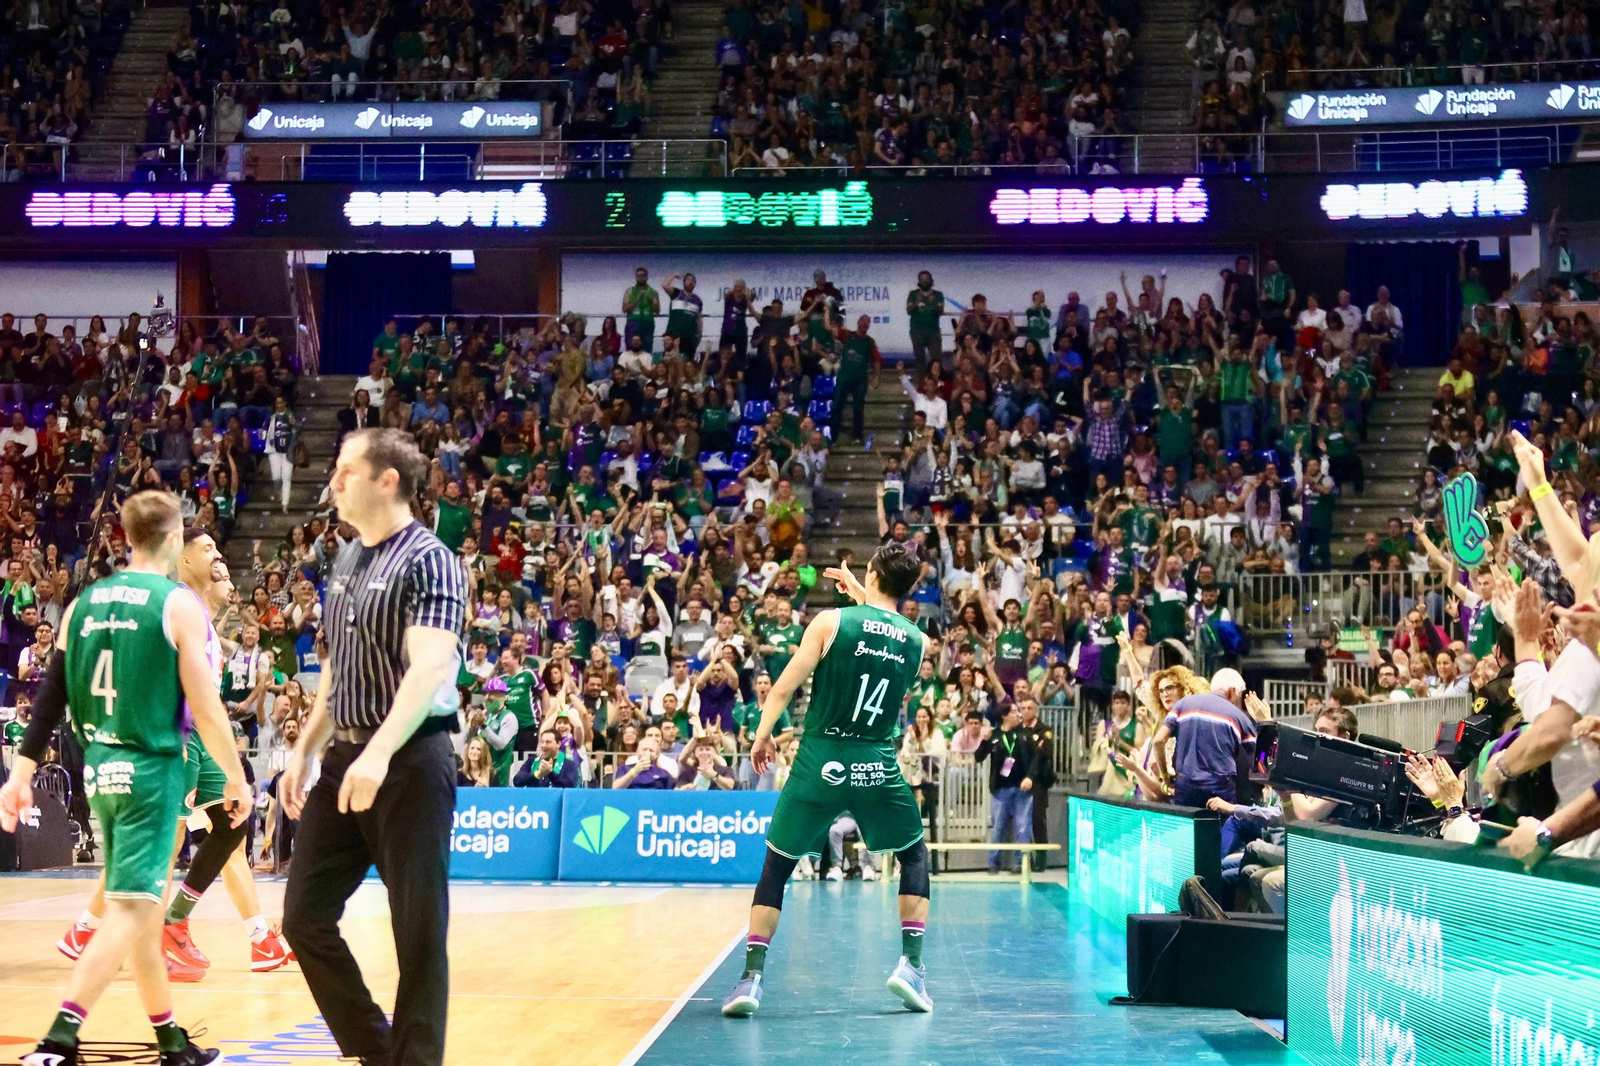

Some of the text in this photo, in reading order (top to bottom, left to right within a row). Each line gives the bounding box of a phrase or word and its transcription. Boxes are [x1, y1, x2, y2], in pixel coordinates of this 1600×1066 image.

[1317, 93, 1386, 108] Fundación
[1446, 88, 1515, 103] Fundación
[1318, 106, 1368, 121] Unicaja
[1446, 101, 1497, 116] Unicaja
[273, 115, 325, 132] Unicaja
[381, 114, 433, 131] Unicaja
[486, 113, 538, 130] Unicaja
[774, 286, 811, 301] MART
[841, 286, 890, 301] ARPENA
[90, 649, 117, 716] 4
[852, 673, 890, 727] 14
[1291, 752, 1309, 760] Canon
[850, 761, 884, 772] COSTA
[850, 771, 885, 780] DEL SOL
[1340, 776, 1366, 789] DIGISUPER
[453, 805, 549, 830] dación
[450, 828, 510, 860] icaja
[636, 833, 737, 864] Unicaja
